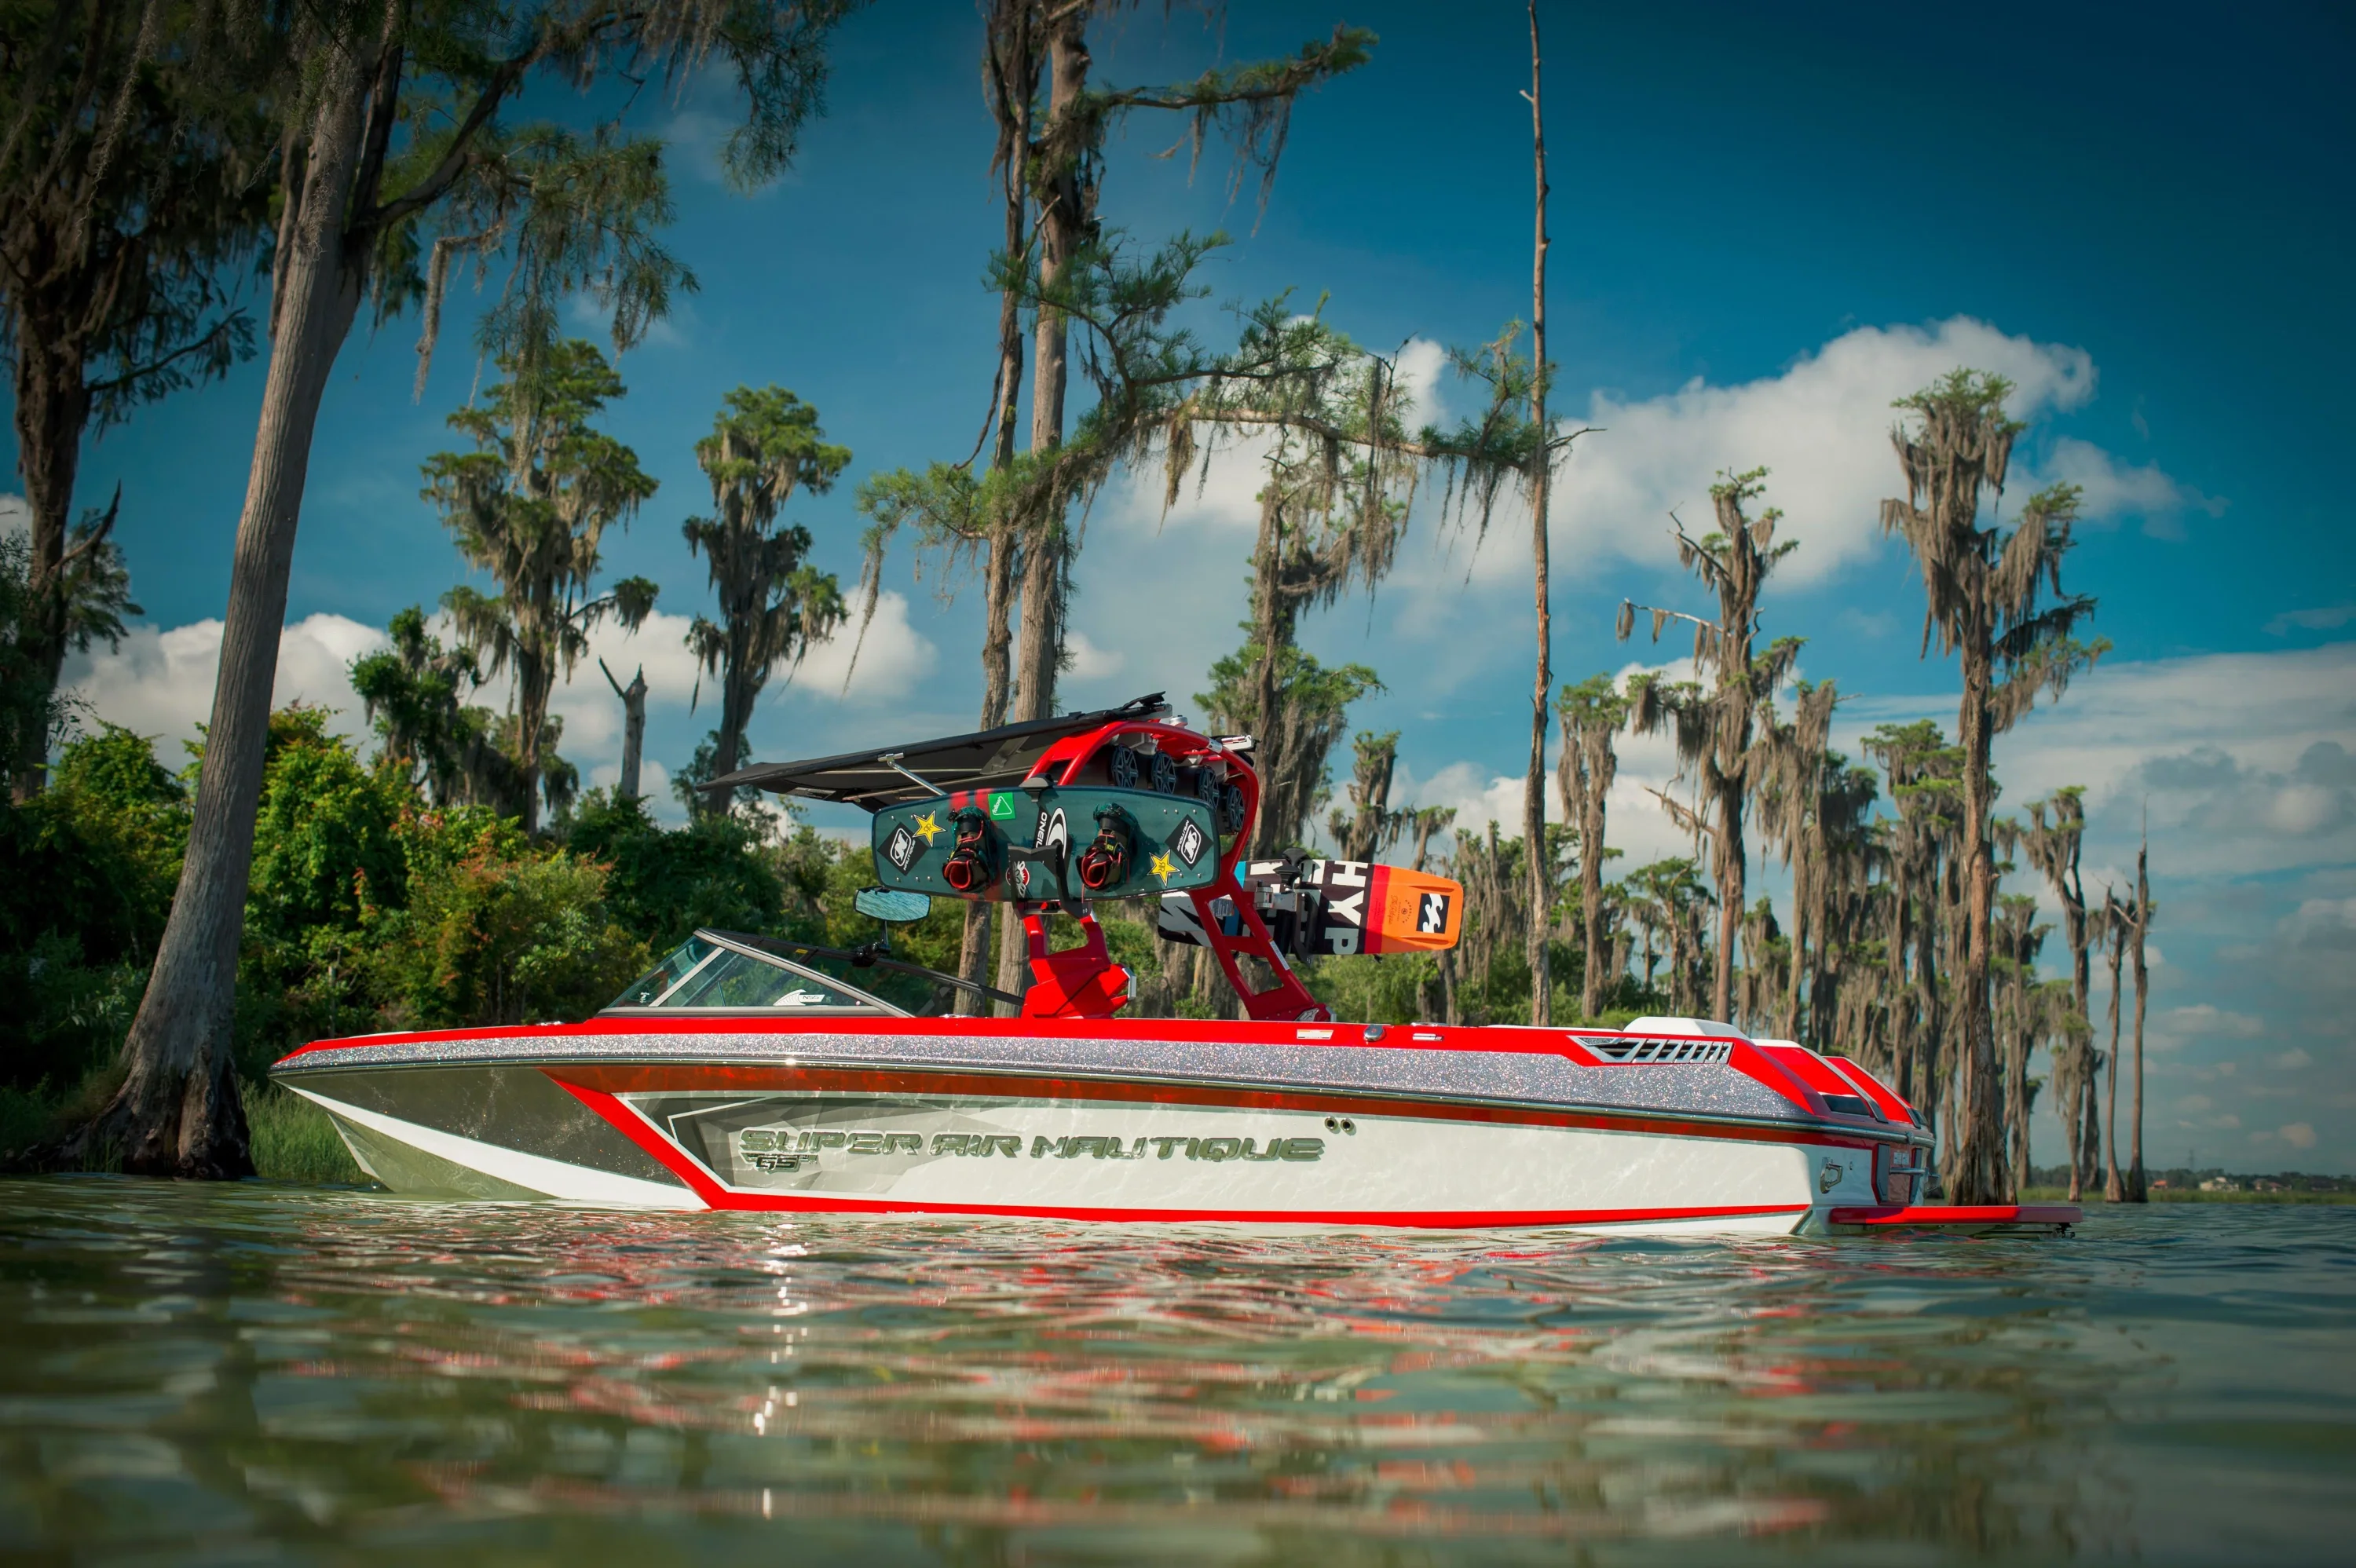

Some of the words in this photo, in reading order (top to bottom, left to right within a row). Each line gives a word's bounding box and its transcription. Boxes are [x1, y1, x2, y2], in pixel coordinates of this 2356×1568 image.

[1036, 811, 1048, 848] O'NEIL
[903, 839, 916, 871] NAUTIQUE
[738, 1129, 923, 1155] SUPER
[929, 1133, 1022, 1158] AIR
[1030, 1135, 1325, 1162] NAUTIQUE
